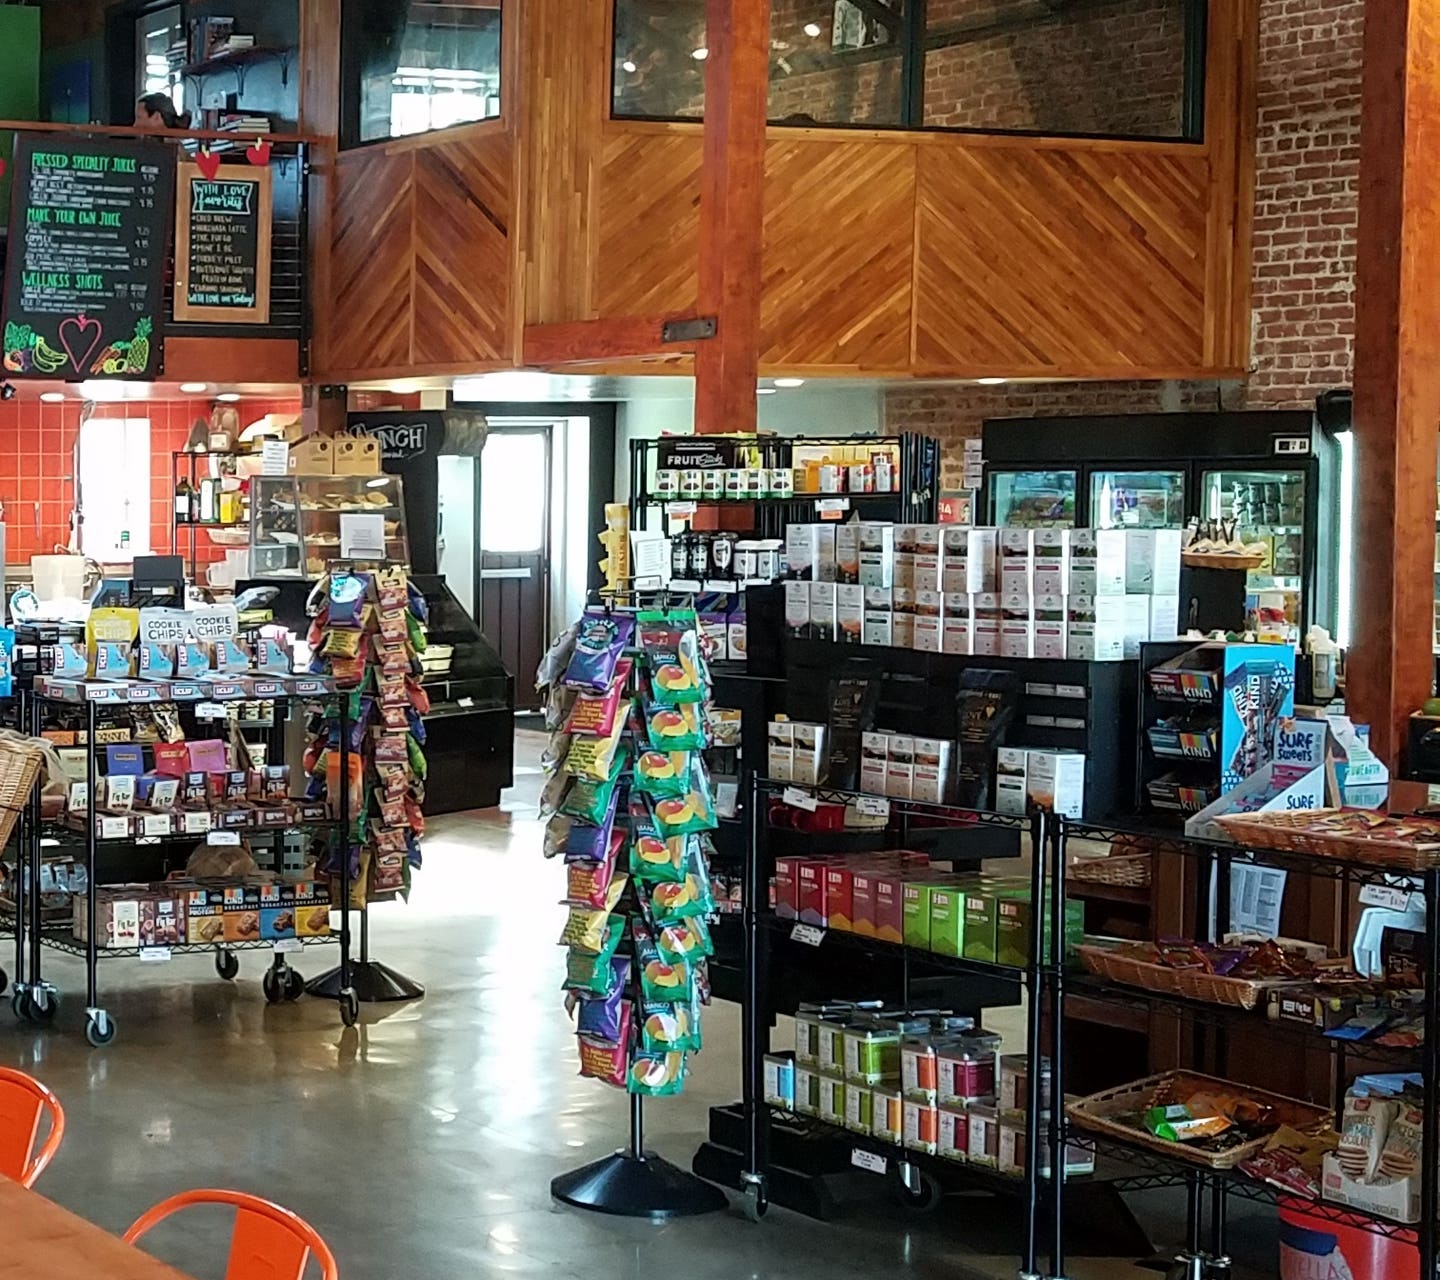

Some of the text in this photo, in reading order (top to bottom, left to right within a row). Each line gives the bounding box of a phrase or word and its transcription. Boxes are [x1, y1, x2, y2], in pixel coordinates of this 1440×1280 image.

[195, 184, 248, 196] WITH LOVE
[27, 208, 122, 227] MAKE YOUR OWN JUICE
[22, 271, 104, 289] WELLNESS SHOTS
[667, 455, 699, 466] FRUIT
[148, 620, 182, 628] COOKIE
[196, 616, 230, 624] COOKIE
[148, 630, 184, 639] CHIPS
[197, 625, 232, 636] CHIPS
[1184, 687, 1213, 699] KIND
[1249, 676, 1260, 709] KIND
[1234, 684, 1249, 718] KIND
[1278, 731, 1313, 748] SURF
[1182, 747, 1210, 758] KIND
[1287, 795, 1314, 810] SURF
